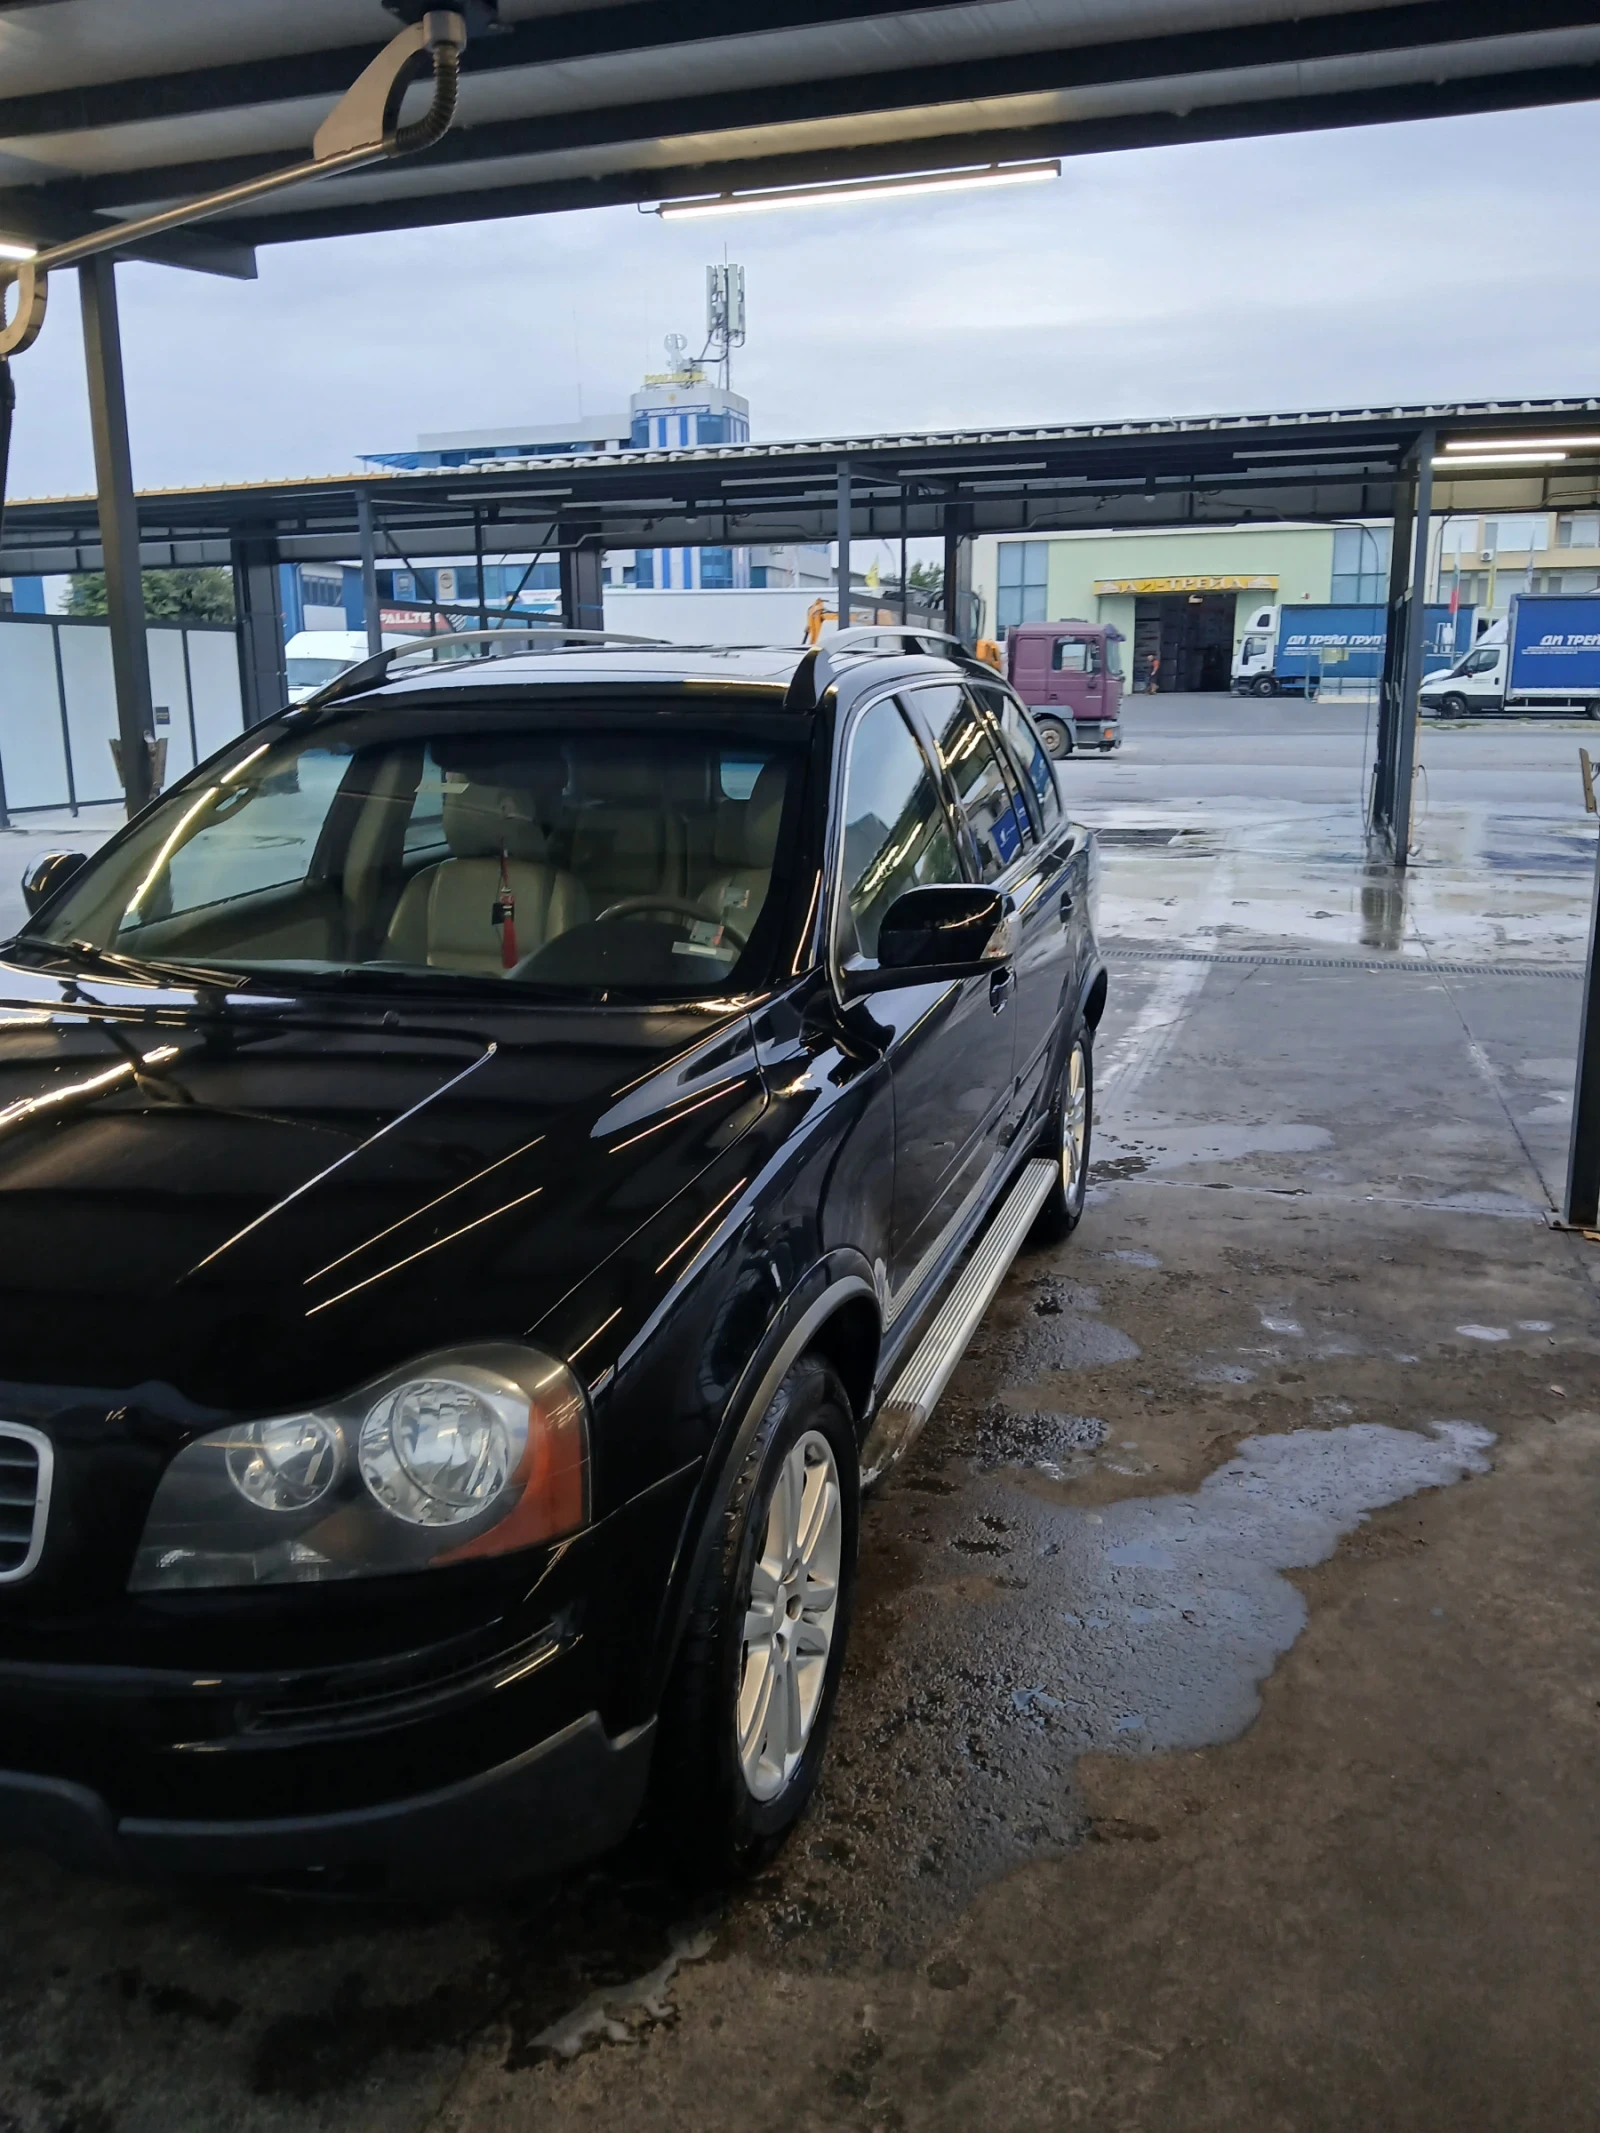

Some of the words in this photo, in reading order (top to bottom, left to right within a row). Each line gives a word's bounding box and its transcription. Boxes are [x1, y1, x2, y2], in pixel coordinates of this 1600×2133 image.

[1286, 635, 1307, 645] ДИ
[1309, 634, 1348, 645] ТРЕЙД
[1349, 635, 1383, 645] ГРУП
[1540, 635, 1564, 645] ДИ
